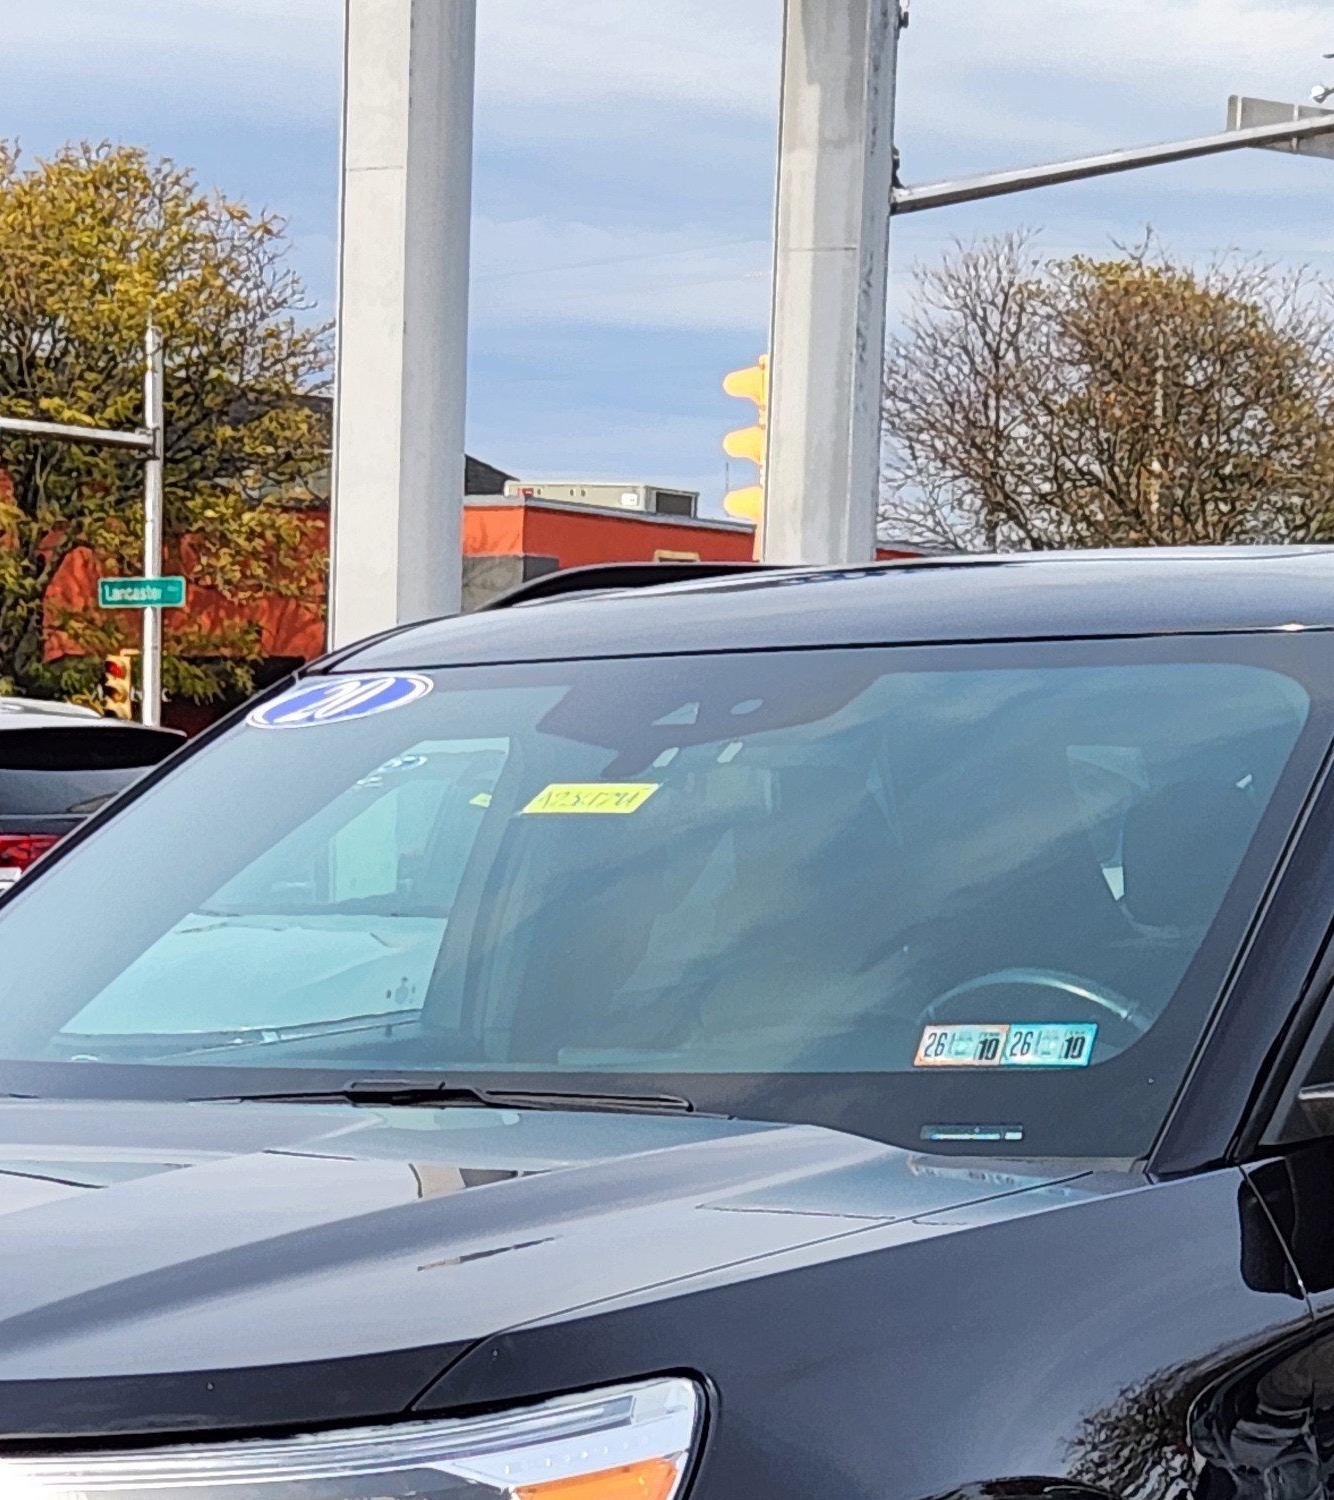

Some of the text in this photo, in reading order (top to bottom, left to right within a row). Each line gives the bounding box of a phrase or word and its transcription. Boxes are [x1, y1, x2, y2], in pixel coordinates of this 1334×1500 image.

[103, 583, 163, 602] Lancaster
[923, 1031, 1001, 1061] 26 10
[1009, 1030, 1087, 1061] 26 10
